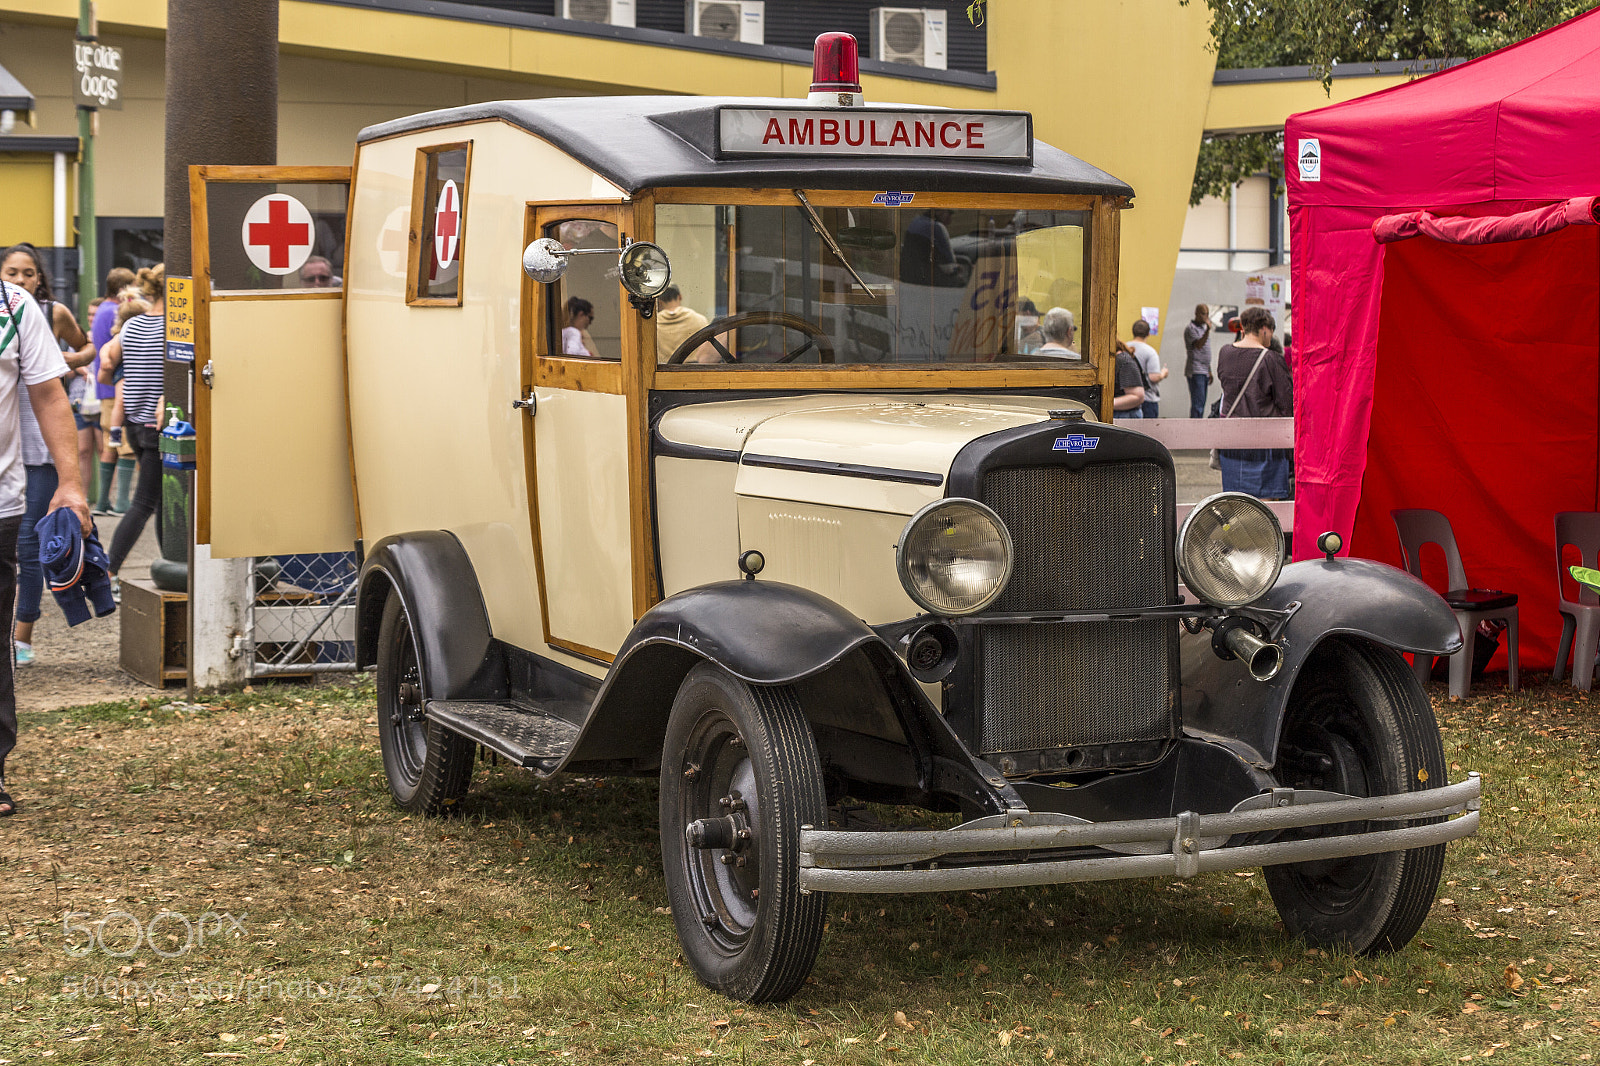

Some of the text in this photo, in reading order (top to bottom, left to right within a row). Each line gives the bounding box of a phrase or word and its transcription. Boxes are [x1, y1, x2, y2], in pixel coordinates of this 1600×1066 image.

[75, 44, 121, 72] ye olde
[762, 117, 985, 149] AMBULANCE
[169, 281, 184, 293] SLIP
[169, 296, 187, 308] SLOP
[169, 311, 187, 323] SLAP
[169, 326, 190, 339] WRAP
[1055, 439, 1097, 448] CHEVROLET
